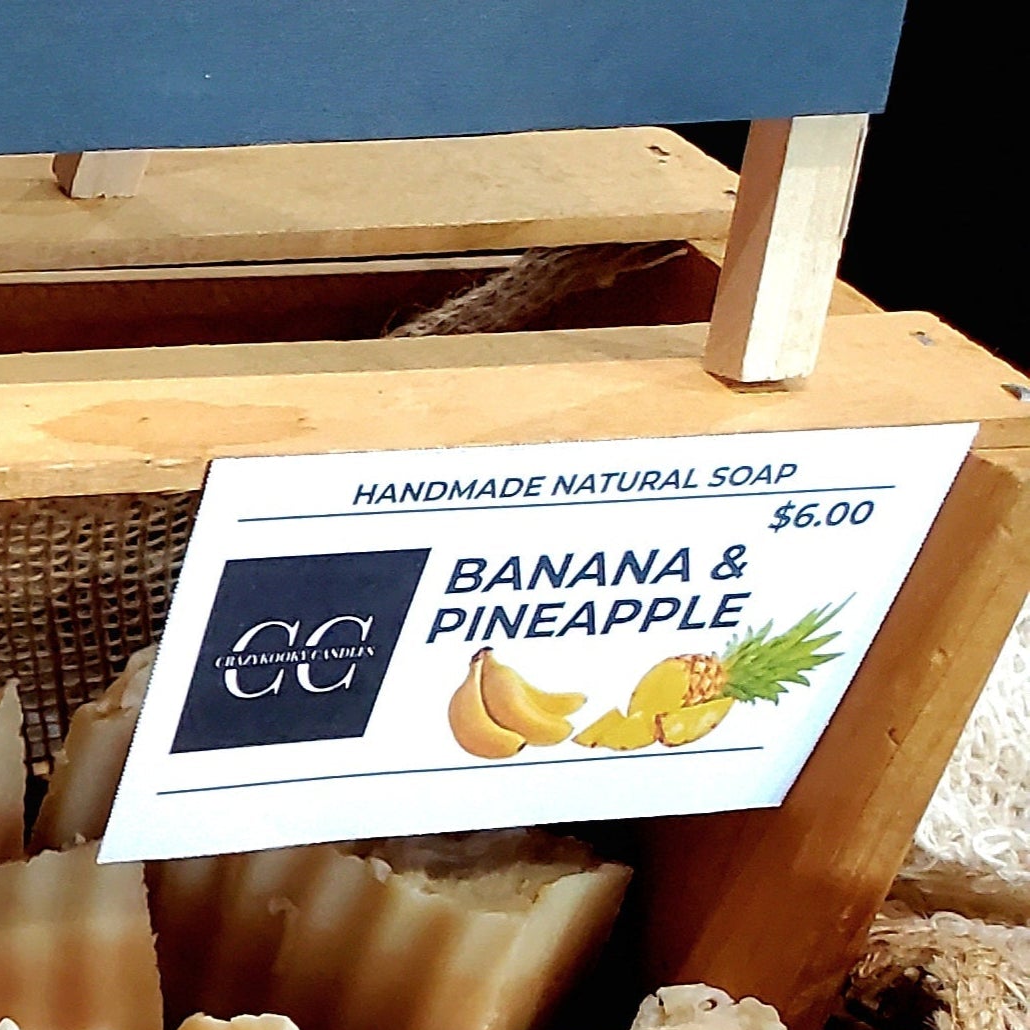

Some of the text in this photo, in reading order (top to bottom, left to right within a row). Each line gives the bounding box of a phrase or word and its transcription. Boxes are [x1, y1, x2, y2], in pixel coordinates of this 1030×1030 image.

[352, 463, 798, 506] HANDMADE NATURAL SOAP
[768, 500, 875, 534] $6.00
[444, 543, 748, 595] BANANA &
[425, 592, 752, 644] PINEAPPLE
